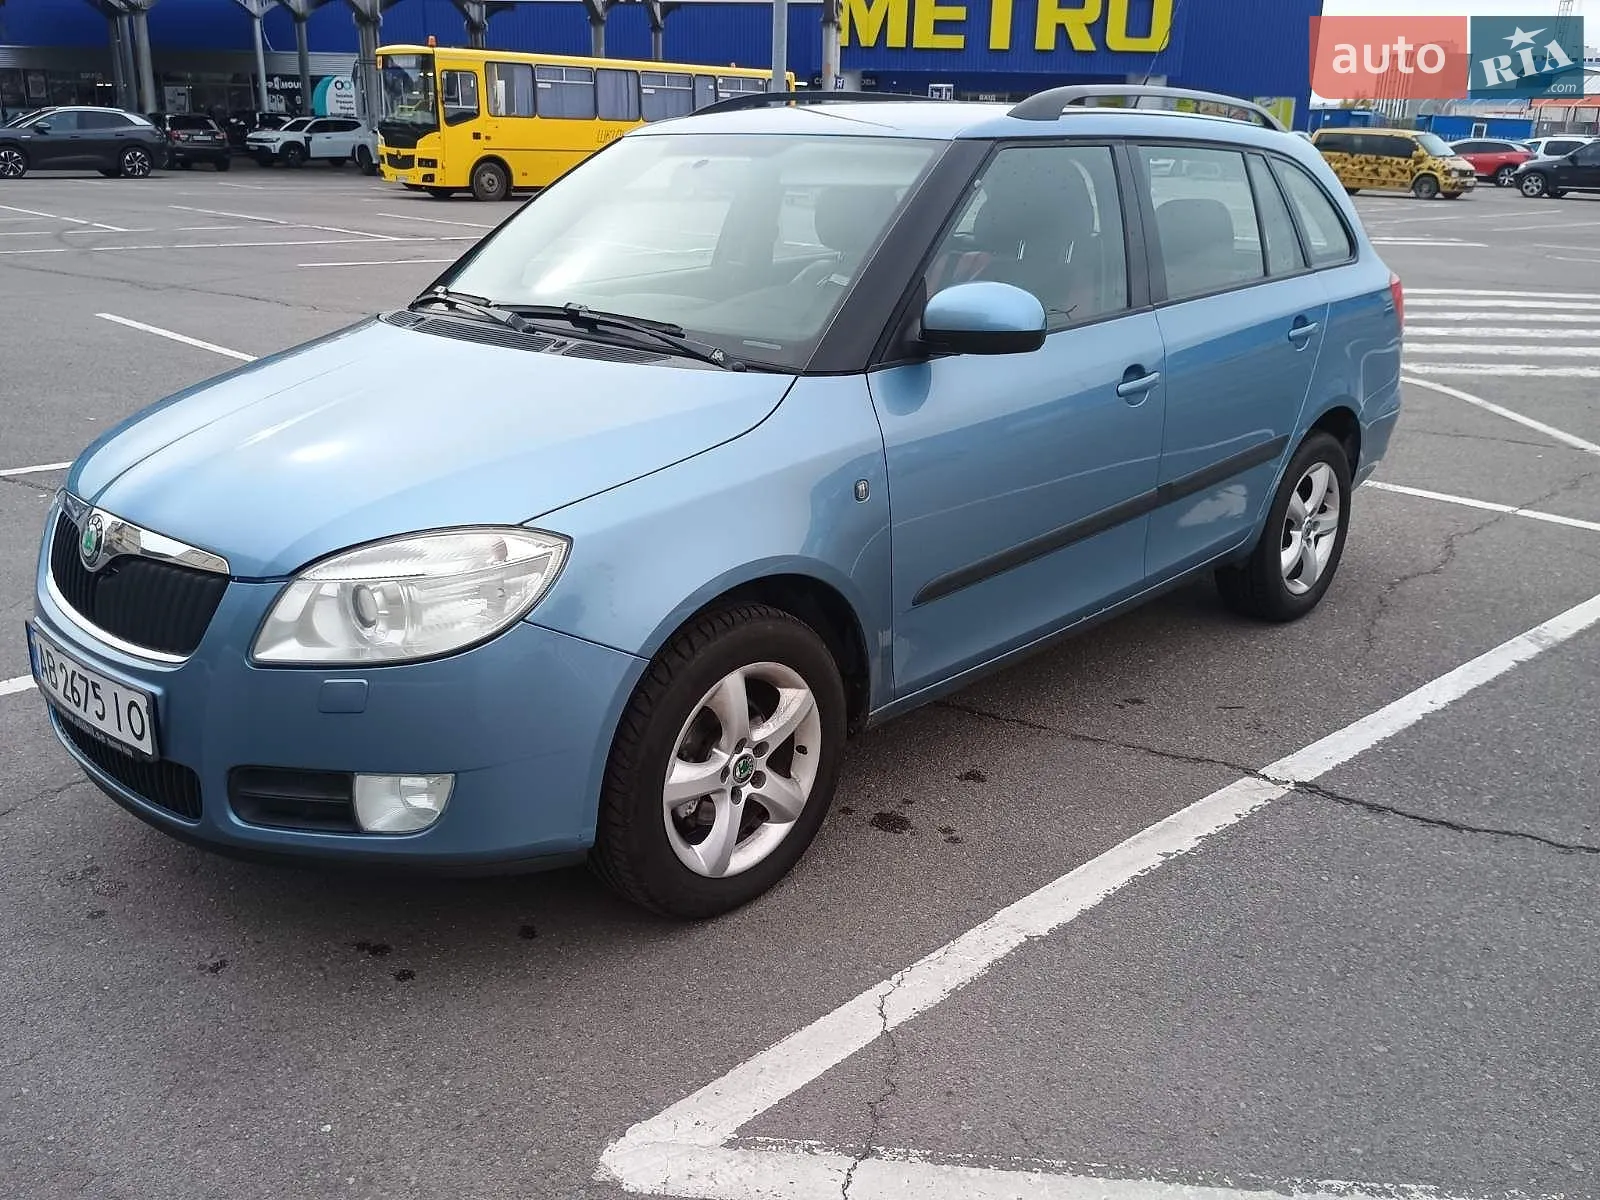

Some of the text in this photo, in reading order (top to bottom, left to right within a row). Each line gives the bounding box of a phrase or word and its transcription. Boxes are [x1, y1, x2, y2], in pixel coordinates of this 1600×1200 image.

[838, 0, 1173, 52] METRO
[39, 643, 58, 690] AB
[59, 662, 106, 721] 2675
[113, 691, 146, 741] IO
